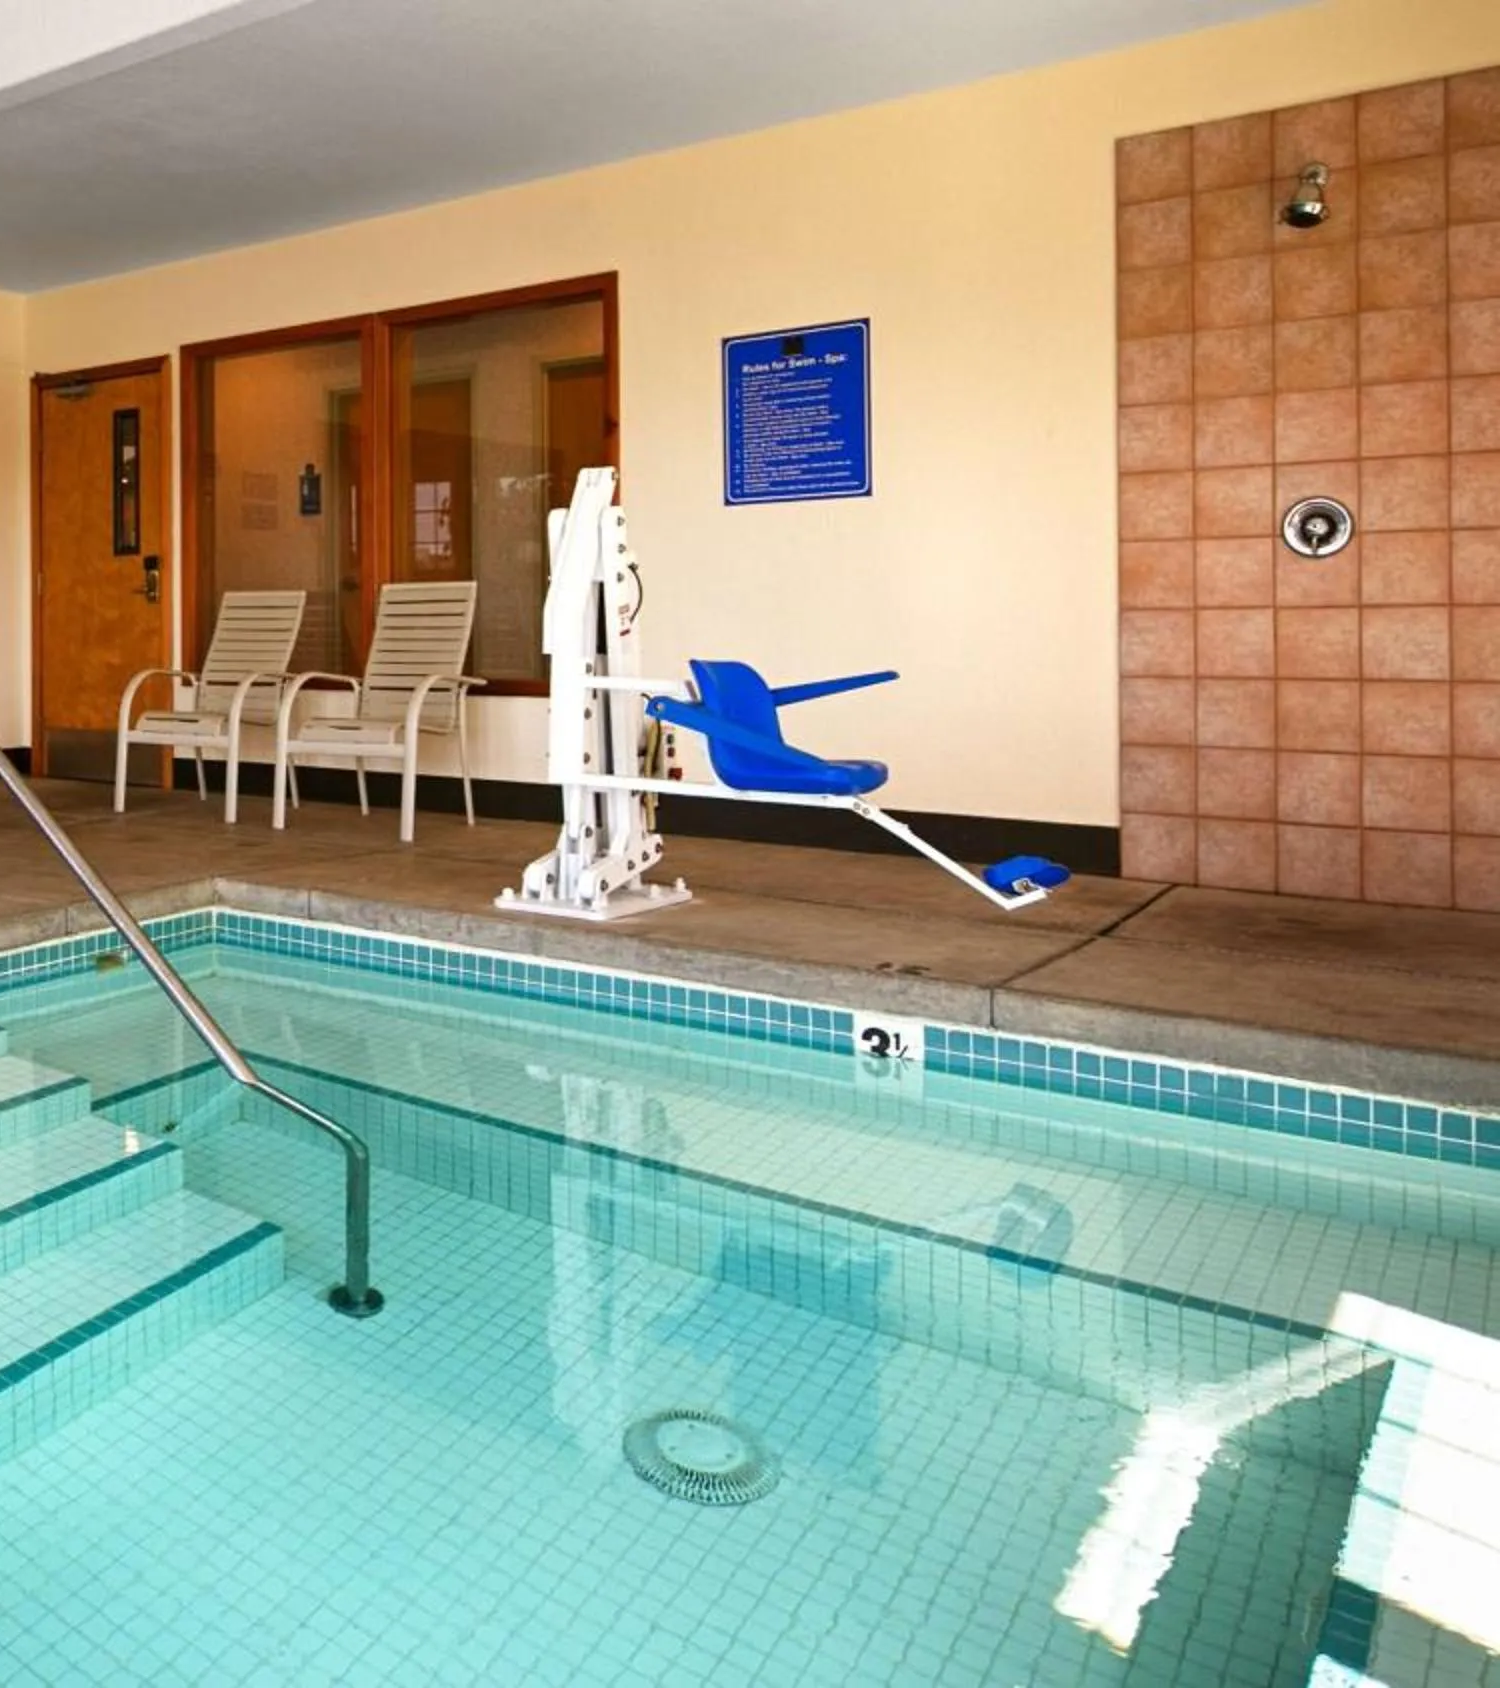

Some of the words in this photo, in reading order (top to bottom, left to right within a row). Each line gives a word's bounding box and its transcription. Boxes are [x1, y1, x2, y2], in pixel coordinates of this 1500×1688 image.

[741, 363, 770, 374] Rules
[771, 360, 786, 371] for
[787, 356, 816, 369] Swim
